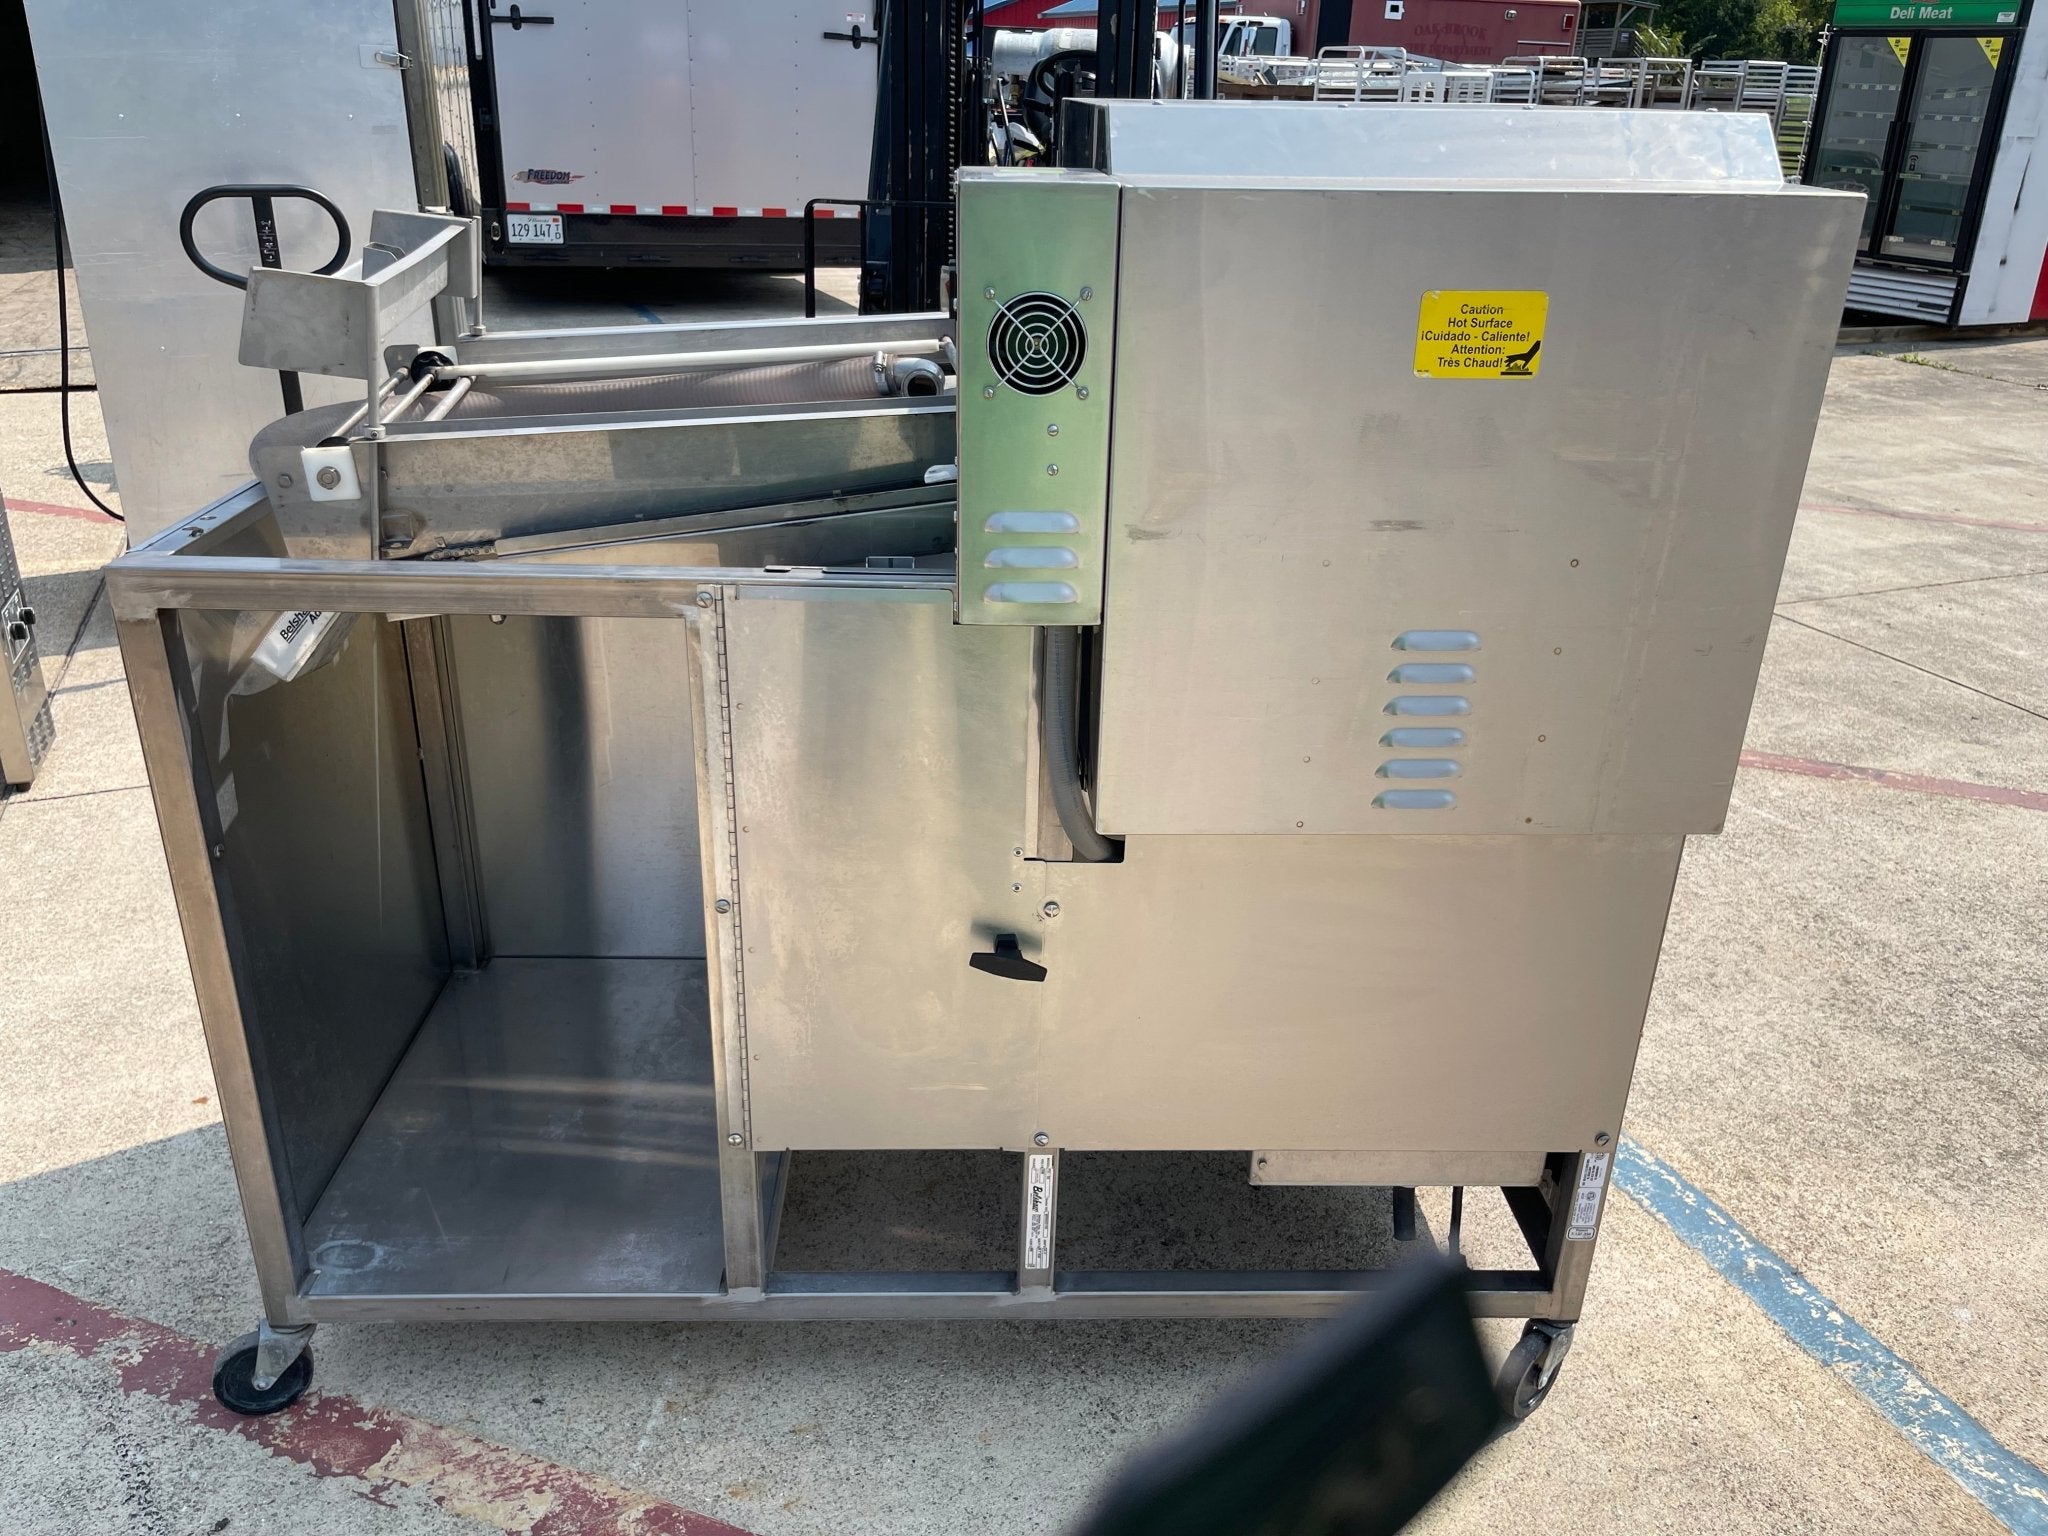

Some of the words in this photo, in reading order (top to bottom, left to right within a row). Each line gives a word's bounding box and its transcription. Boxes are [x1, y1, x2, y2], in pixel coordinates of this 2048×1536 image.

[1890, 7, 1914, 19] Deli
[1918, 7, 1953, 19] Meat
[527, 168, 571, 180] FREEDOM
[511, 223, 530, 237] 129
[533, 223, 552, 238] 147
[1460, 304, 1504, 315] Caution
[1448, 318, 1467, 328] Hot
[1470, 318, 1513, 329] Surface
[1481, 331, 1530, 342] Caliente!
[1451, 344, 1506, 355] Attention:
[1438, 357, 1460, 368] Très
[1463, 357, 1503, 368] Chaud!
